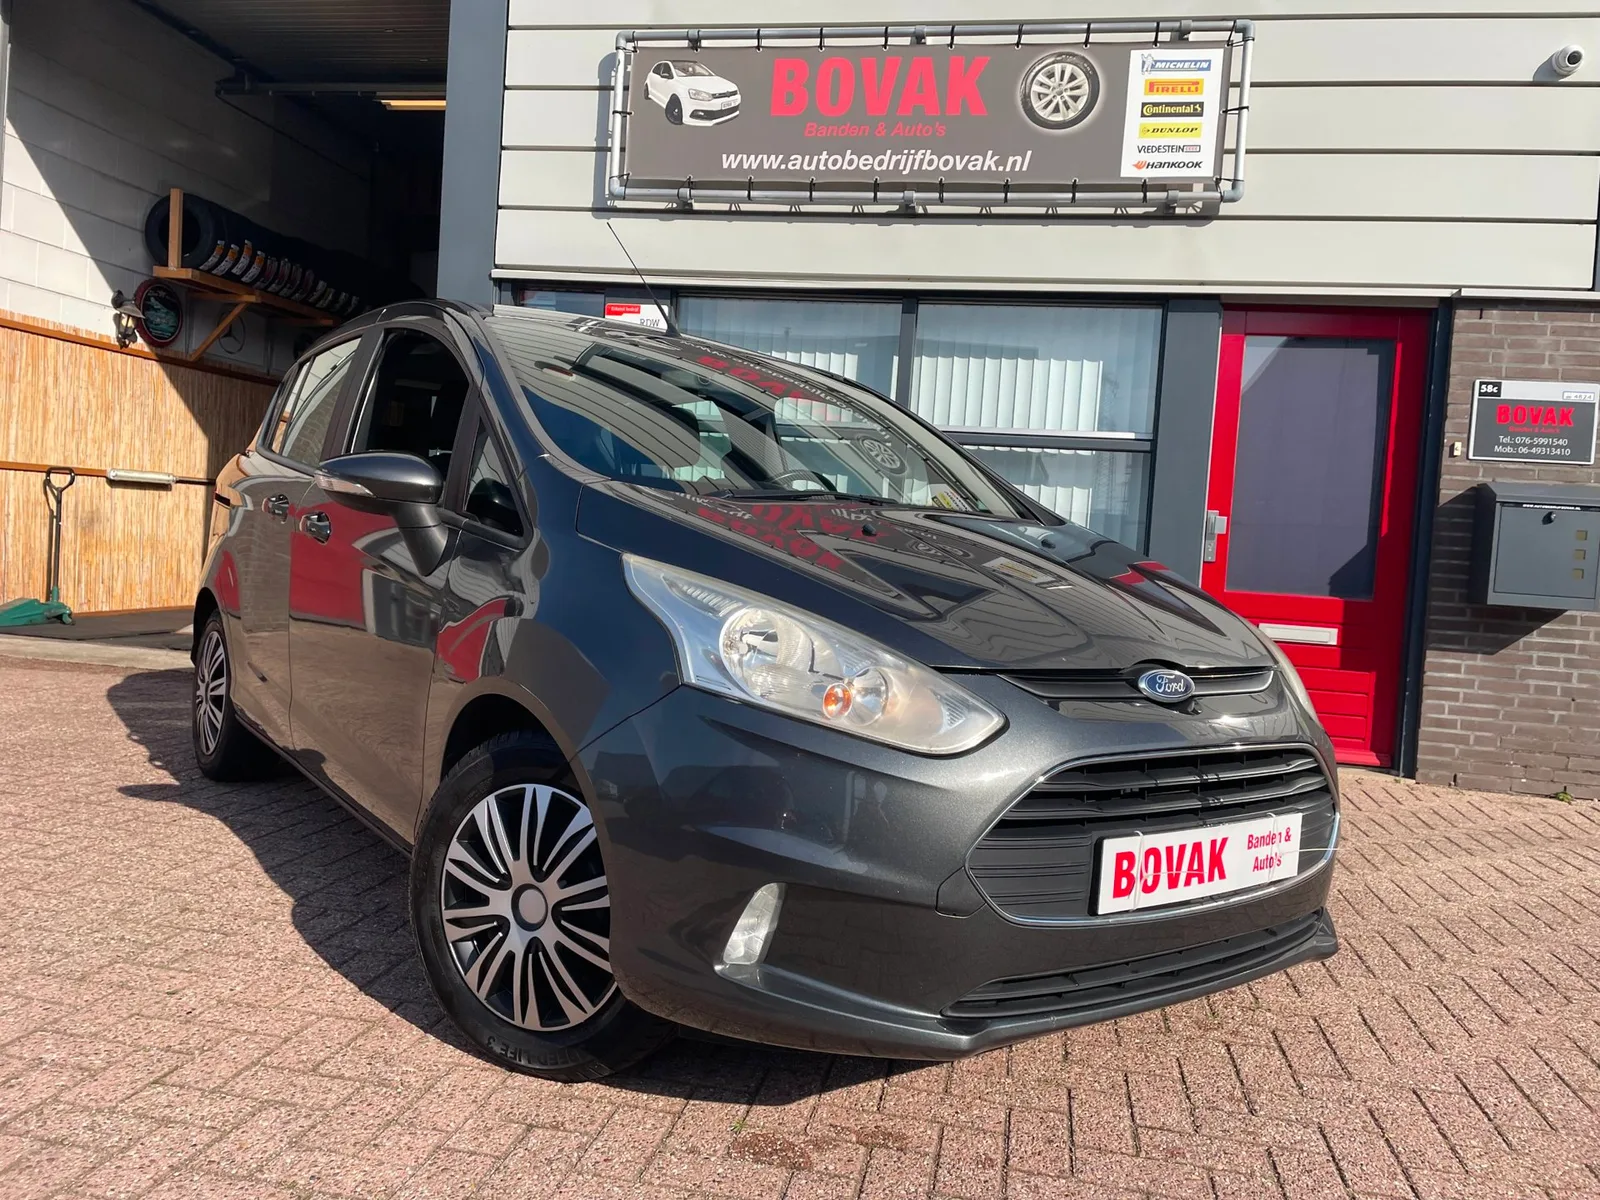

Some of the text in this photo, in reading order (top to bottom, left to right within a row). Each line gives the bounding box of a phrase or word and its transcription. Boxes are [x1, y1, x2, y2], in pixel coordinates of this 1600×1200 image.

[1155, 61, 1209, 69] MICHELIN
[770, 56, 991, 117] BOVAK
[1148, 81, 1200, 93] PIRELLI
[1143, 104, 1194, 116] Continental
[804, 122, 947, 137] Banden & Auto's
[1137, 145, 1185, 153] VREDESTEIN
[721, 150, 1033, 175] www.autobedrijfbovak.nl
[640, 318, 660, 327] RDW
[1480, 384, 1499, 393] 58c
[1496, 404, 1575, 427] BOVAK
[1515, 436, 1569, 446] 076-5991540
[1518, 446, 1571, 456] 06-49313410
[1155, 674, 1186, 693] Ford
[1284, 827, 1292, 843] &
[1113, 837, 1229, 899] BOVAK
[1253, 852, 1282, 872] Auto's
